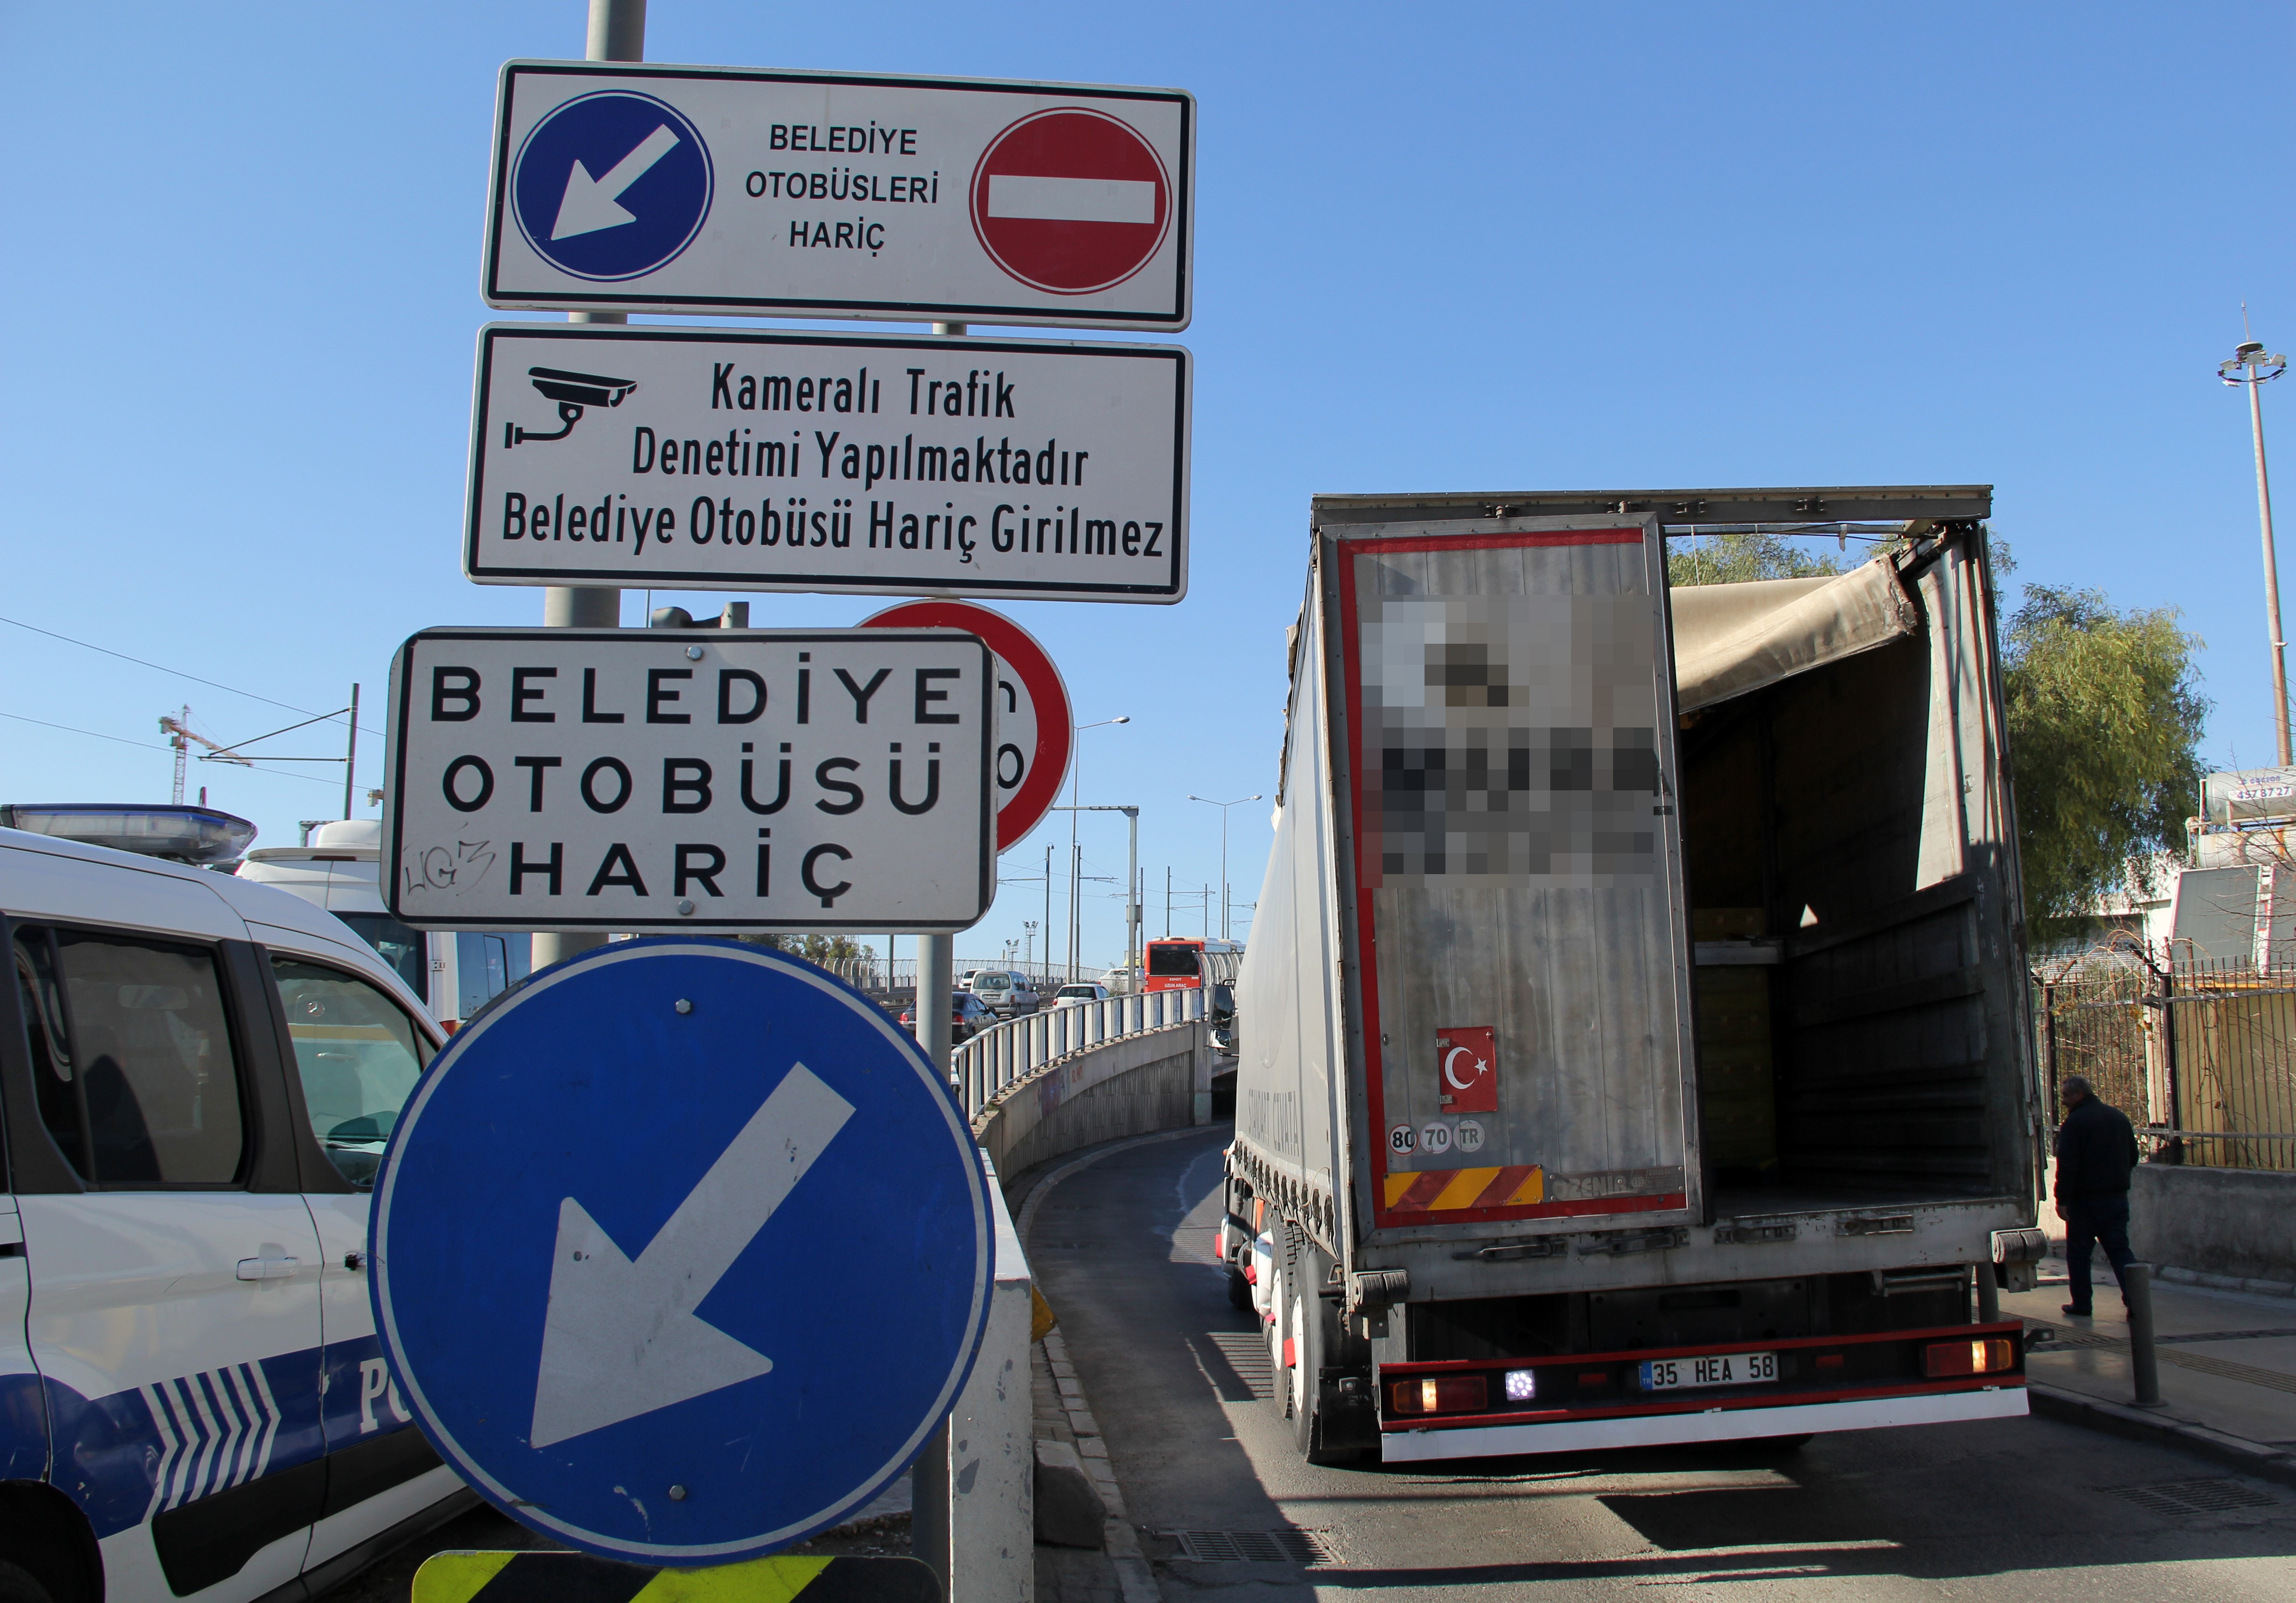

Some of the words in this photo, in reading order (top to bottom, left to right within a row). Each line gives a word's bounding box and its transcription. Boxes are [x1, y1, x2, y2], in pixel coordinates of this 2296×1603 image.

[770, 120, 918, 155] BELEDİYE
[746, 167, 939, 204] OTOBÜSLERİ
[790, 216, 885, 257] HARİÇ
[712, 363, 880, 413] Kameralı
[906, 368, 1015, 418] Trafik
[633, 426, 800, 478] Denetimi
[815, 431, 1089, 492] Yapılmaktadır
[503, 492, 675, 556] Belediye
[690, 496, 852, 548] Otobüsü
[869, 501, 977, 564] Hariç
[992, 504, 1163, 558] Girilmez
[431, 652, 961, 725] BELEDİYE
[442, 742, 940, 816] OTOBÜSÜ
[509, 827, 853, 909] HARİÇ
[1392, 1131, 1415, 1148] 80
[1425, 1128, 1447, 1145] 70
[1460, 1128, 1479, 1144] TR
[1653, 1362, 1678, 1386] 35
[1695, 1358, 1733, 1383] HEA
[1749, 1355, 1774, 1378] 58
